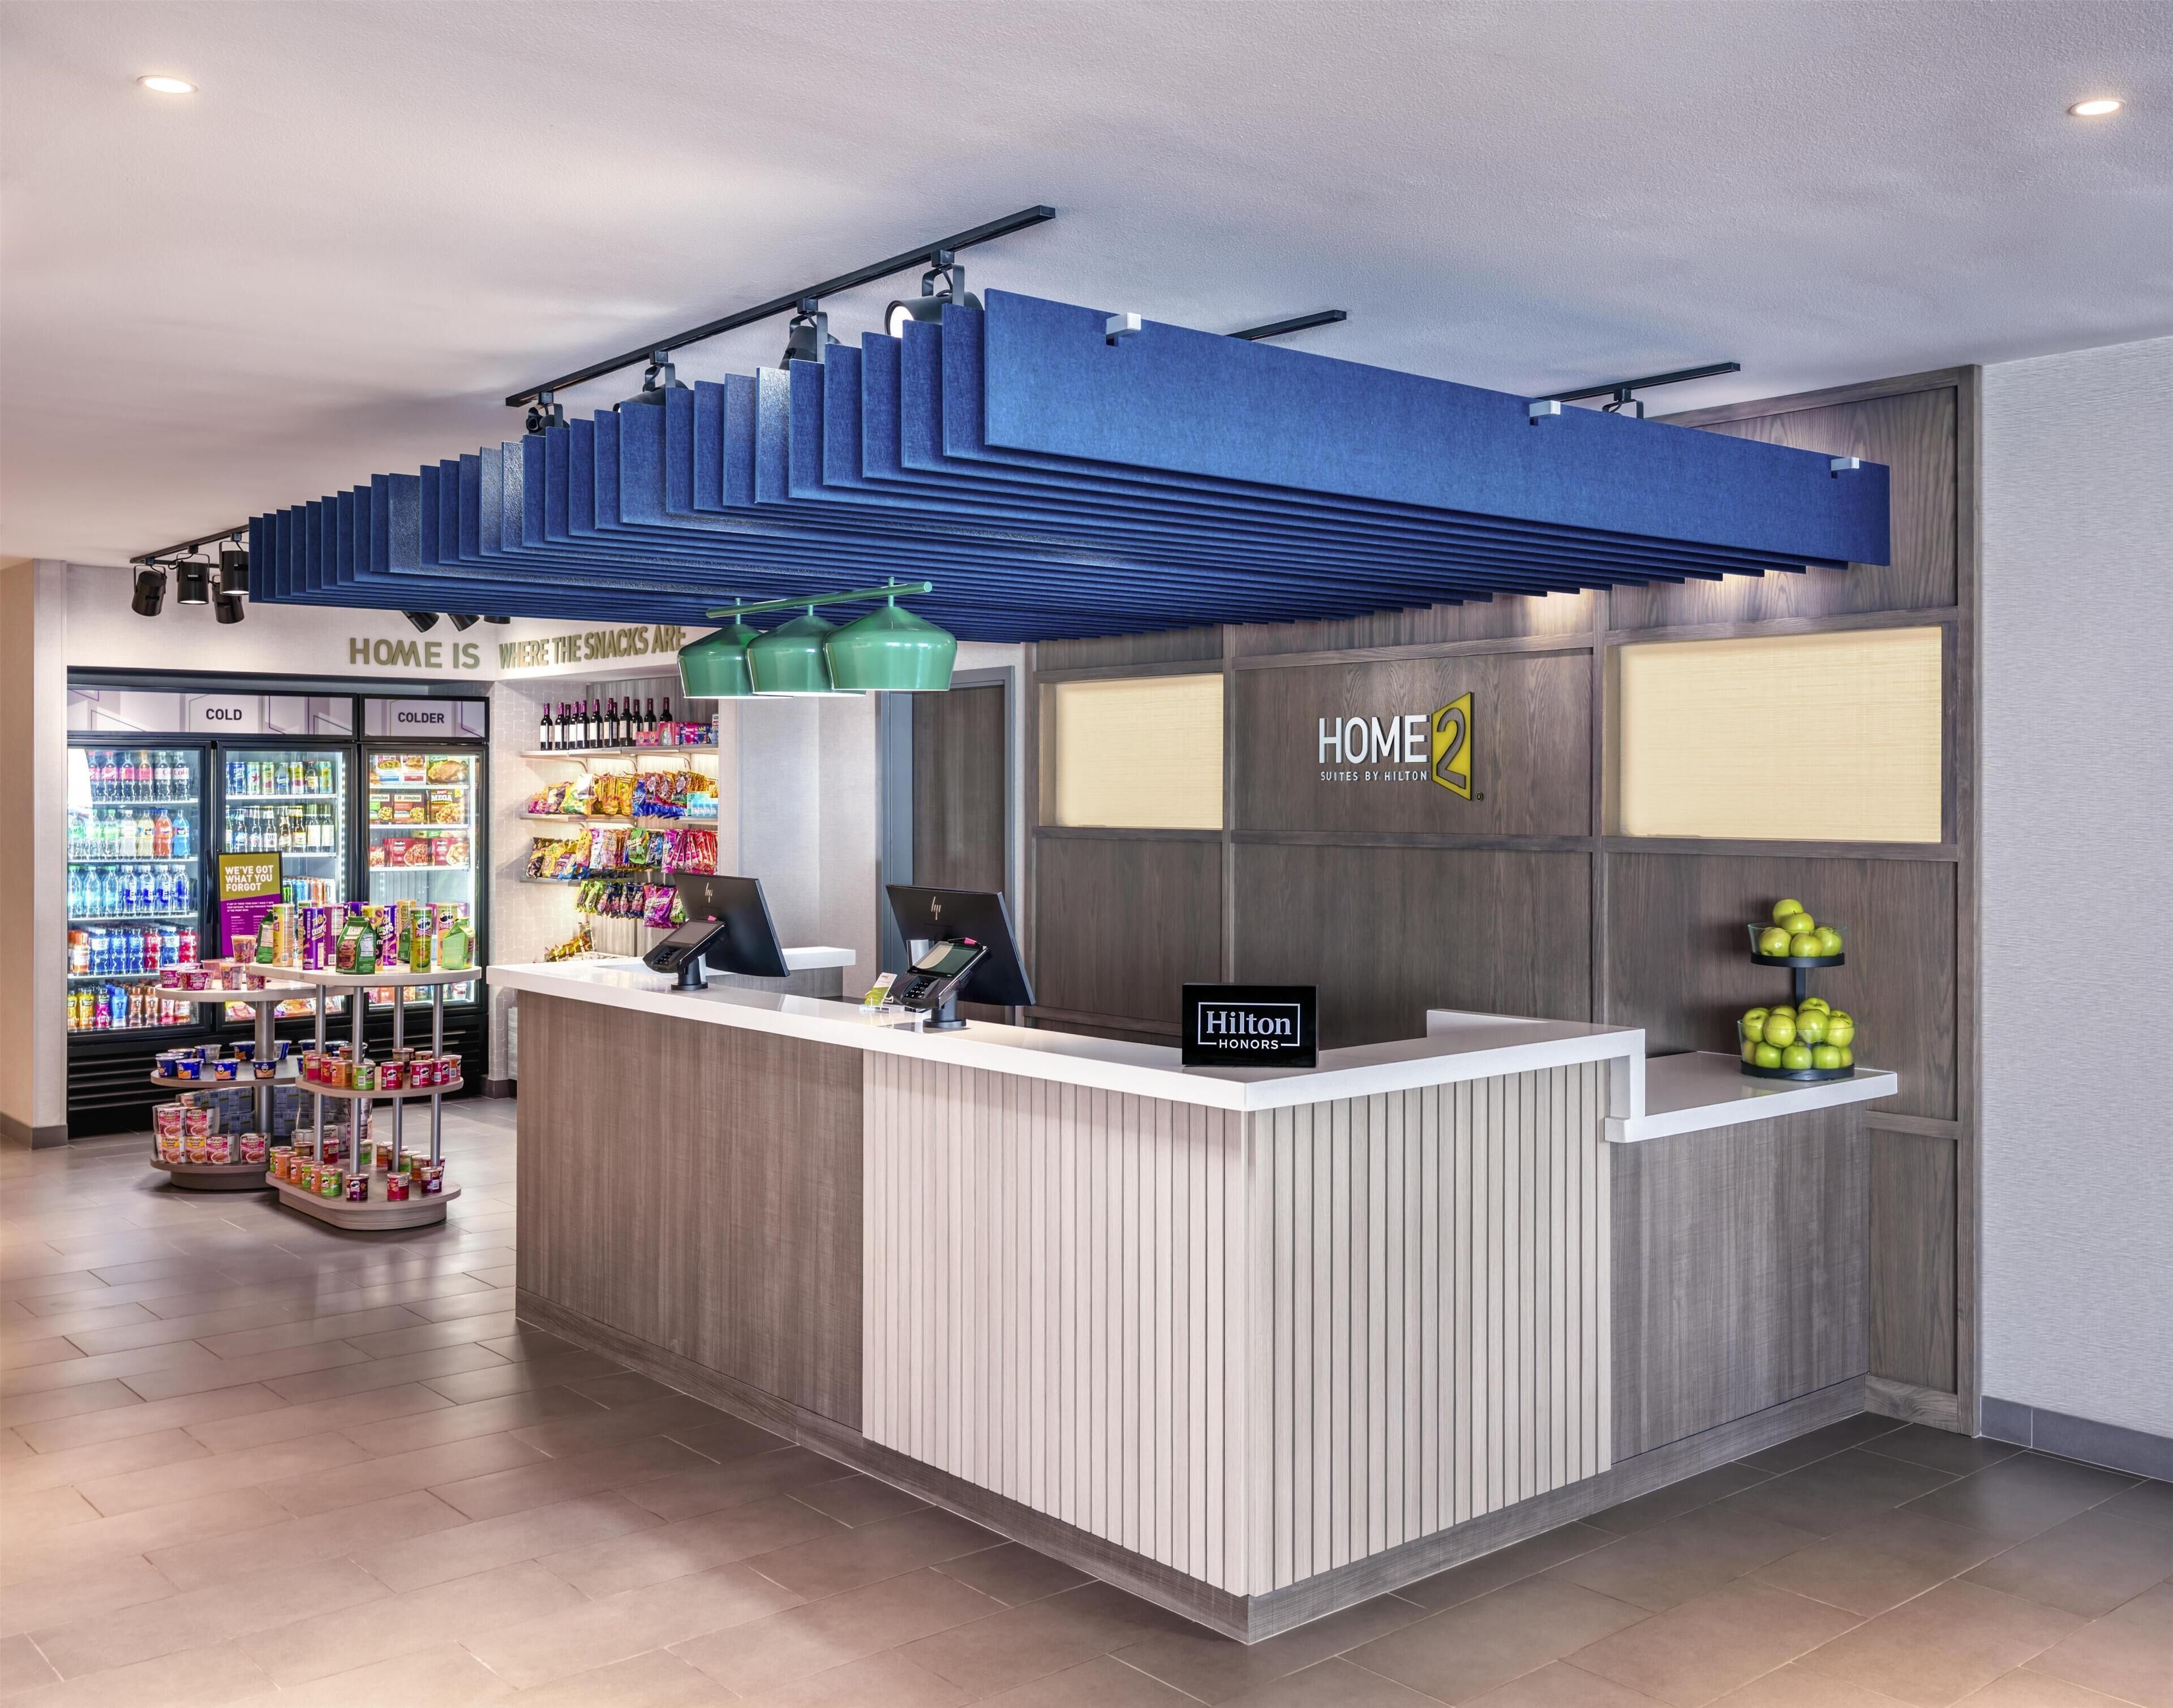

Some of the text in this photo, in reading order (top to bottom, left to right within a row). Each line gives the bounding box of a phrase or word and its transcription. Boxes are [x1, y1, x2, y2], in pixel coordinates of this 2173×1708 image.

[349, 637, 480, 669] HOME IS
[499, 625, 686, 670] WHERE THE SNACKS ARE
[206, 708, 242, 720] COLD
[398, 712, 445, 724] COLDER
[1320, 771, 1427, 781] SUITES BY HILTON
[225, 865, 274, 875] WE'VE GOT
[225, 874, 273, 883] WHAT YOU
[226, 883, 262, 892] FORGOT
[705, 882, 713, 903] hp
[931, 896, 942, 920] hp
[1206, 1011, 1291, 1035] Hilton
[1219, 1039, 1279, 1049] HONORS
